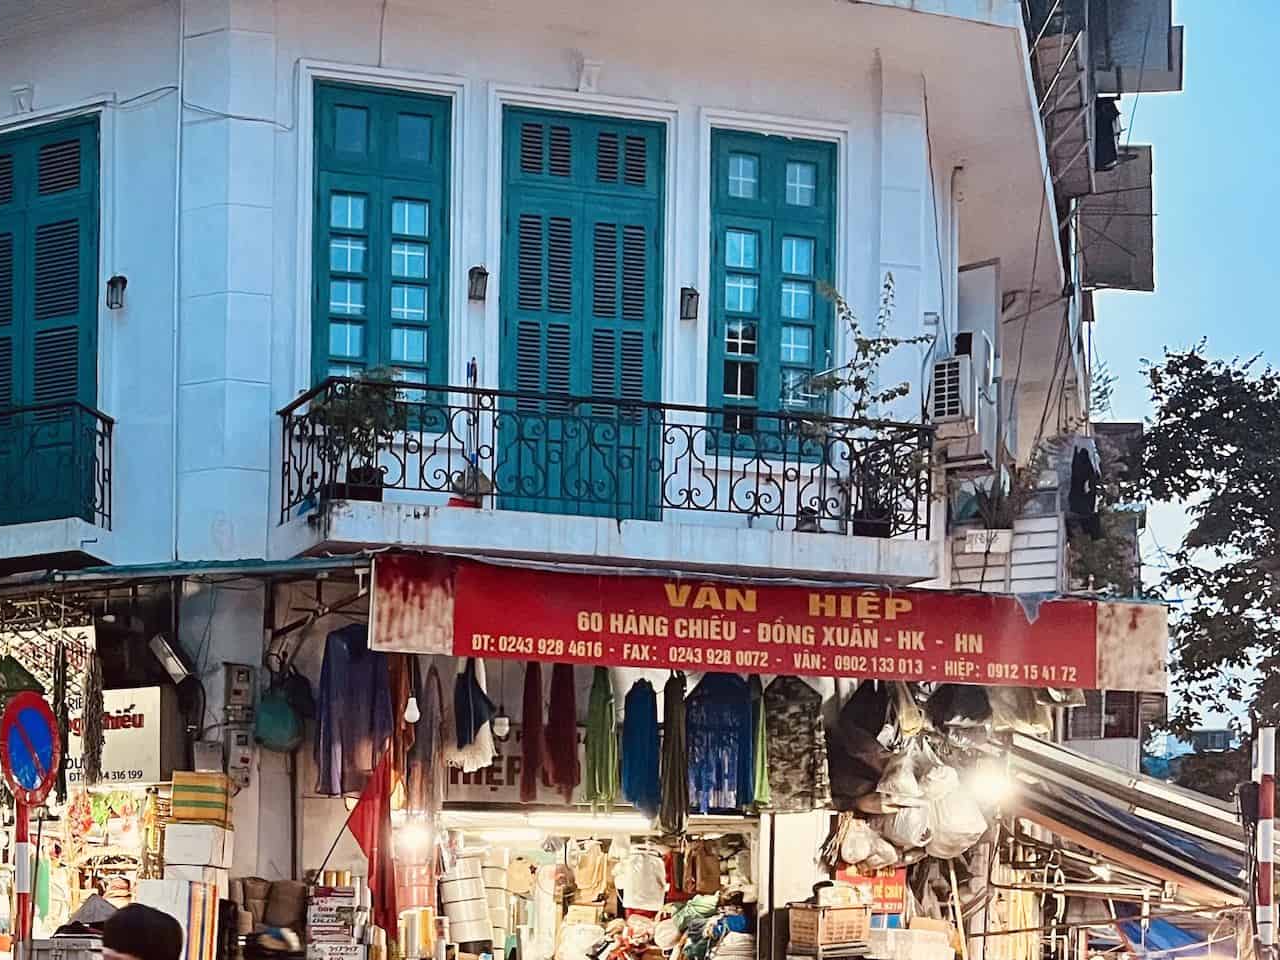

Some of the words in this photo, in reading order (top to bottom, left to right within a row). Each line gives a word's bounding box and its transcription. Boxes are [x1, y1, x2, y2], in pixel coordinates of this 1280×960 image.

[664, 582, 757, 612] VÂN
[808, 591, 912, 624] HIỆP
[577, 611, 603, 634] 60
[674, 614, 736, 642] CHIẾU
[757, 616, 815, 646] ĐỒNG
[821, 626, 879, 649] XUÂN
[898, 631, 925, 651] HK
[954, 633, 984, 654] HN
[472, 634, 495, 651] ĐT:
[498, 635, 533, 653] 0243
[538, 639, 564, 655] 928
[568, 641, 602, 658] 4616
[669, 646, 702, 664] 0243
[707, 649, 732, 665] 928
[735, 651, 769, 668] 0072
[793, 652, 827, 670] VÂN:
[834, 655, 867, 672] 0902
[898, 658, 923, 674] 013
[945, 657, 980, 680] HIỆP:
[987, 663, 1019, 679] 0912
[1023, 665, 1038, 680] 15
[1060, 666, 1077, 682] 72
